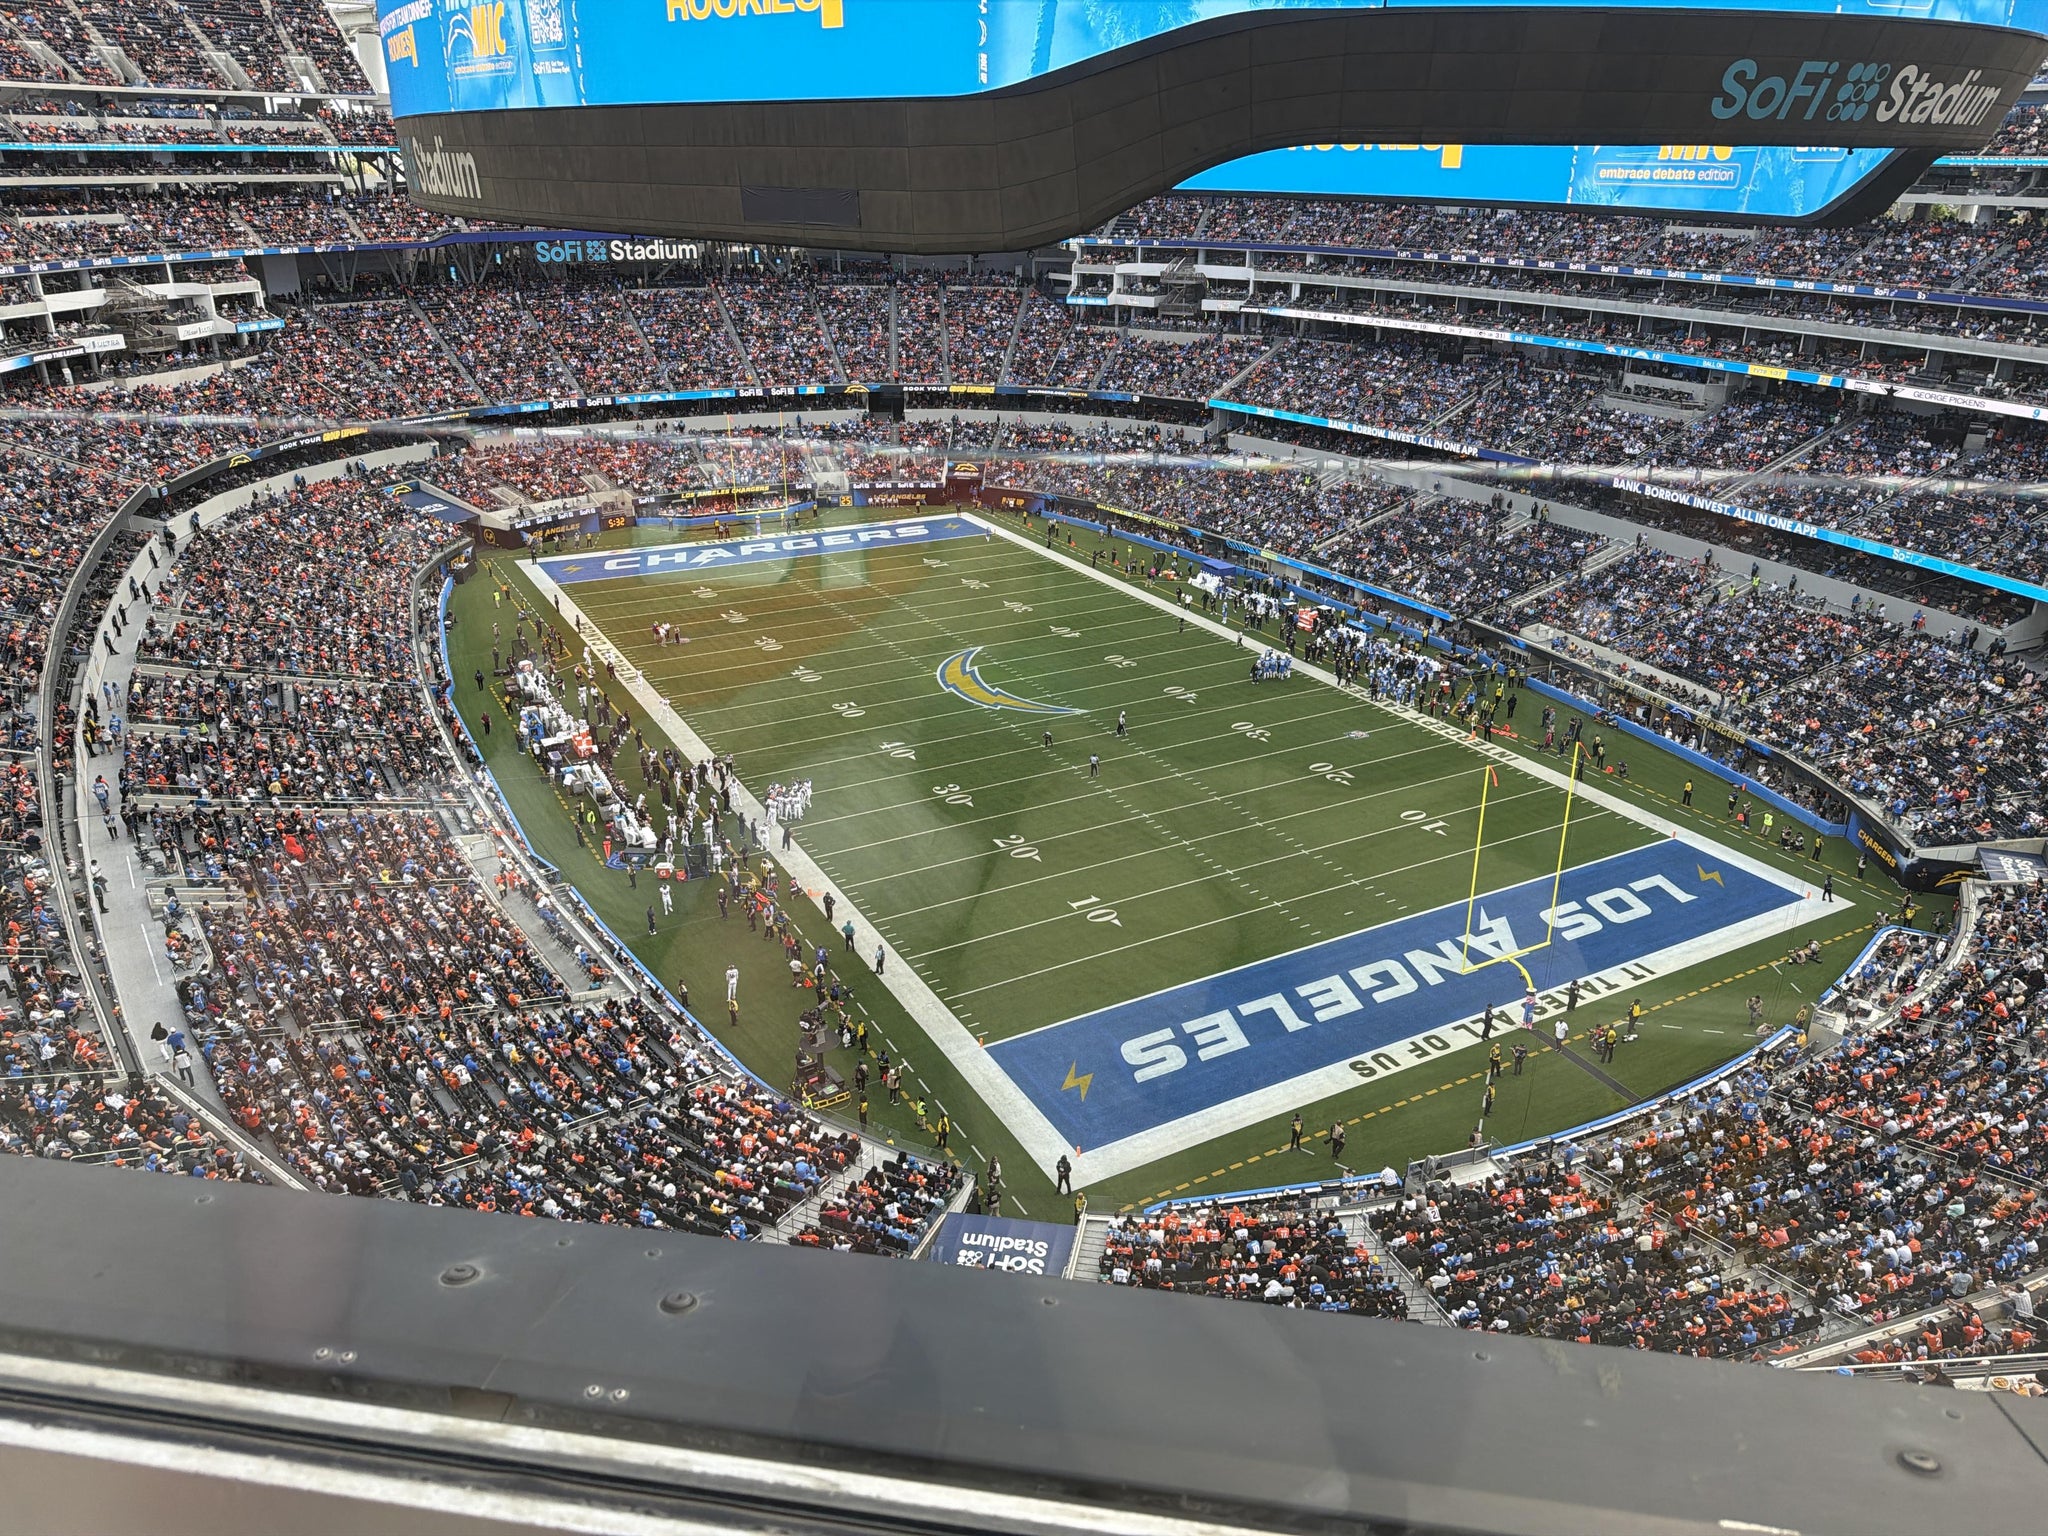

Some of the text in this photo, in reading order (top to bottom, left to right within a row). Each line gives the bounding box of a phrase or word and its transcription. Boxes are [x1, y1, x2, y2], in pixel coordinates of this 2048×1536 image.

[472, 2, 506, 58] MIC
[1711, 58, 2001, 126] SoFi Stadium
[412, 136, 482, 199] Stadium
[1599, 168, 1734, 181] embrace debate edition
[536, 240, 698, 262] SoFi Stadium
[553, 401, 569, 409] SoFi
[586, 398, 603, 406] SoFi
[1914, 390, 1985, 408] GEORGE PICKENS
[2032, 408, 2040, 419] 9
[279, 441, 298, 451] BOOK
[299, 436, 321, 446] YOUR
[1328, 420, 1478, 457] BANK. BORROW. INVEST. ALL IN ONE APP.
[697, 488, 730, 498] ANGELES
[732, 486, 770, 494] CHARGERS
[1096, 504, 1179, 530] CHARGERS.COM/TICKETS
[1612, 477, 1817, 538] BANK. BORROW. INVEST. ALL IN ONE APP.
[544, 522, 580, 536] ANGELES
[608, 516, 625, 528] 5:32
[604, 524, 930, 571] CHARGERS
[1104, 655, 1137, 668] 50
[791, 668, 822, 682] 40
[1163, 686, 1198, 702] 40
[1608, 678, 1667, 708] LOS ANGELES
[832, 702, 865, 717] 50
[1231, 722, 1272, 739] 30
[1695, 716, 1746, 744] CHARGERS
[879, 742, 915, 757] 40
[1309, 763, 1355, 782] 20
[932, 784, 972, 804] 30
[1400, 810, 1450, 833] 10
[992, 834, 1038, 858] 20
[1858, 829, 1896, 868] CHARGERS
[1067, 895, 1117, 922] 10
[1120, 874, 1698, 1083] LOS ANGELES
[1620, 962, 1657, 982] IT
[1408, 1034, 1450, 1060] OF
[1349, 1052, 1401, 1078] US
[962, 1232, 1048, 1258] Stadium
